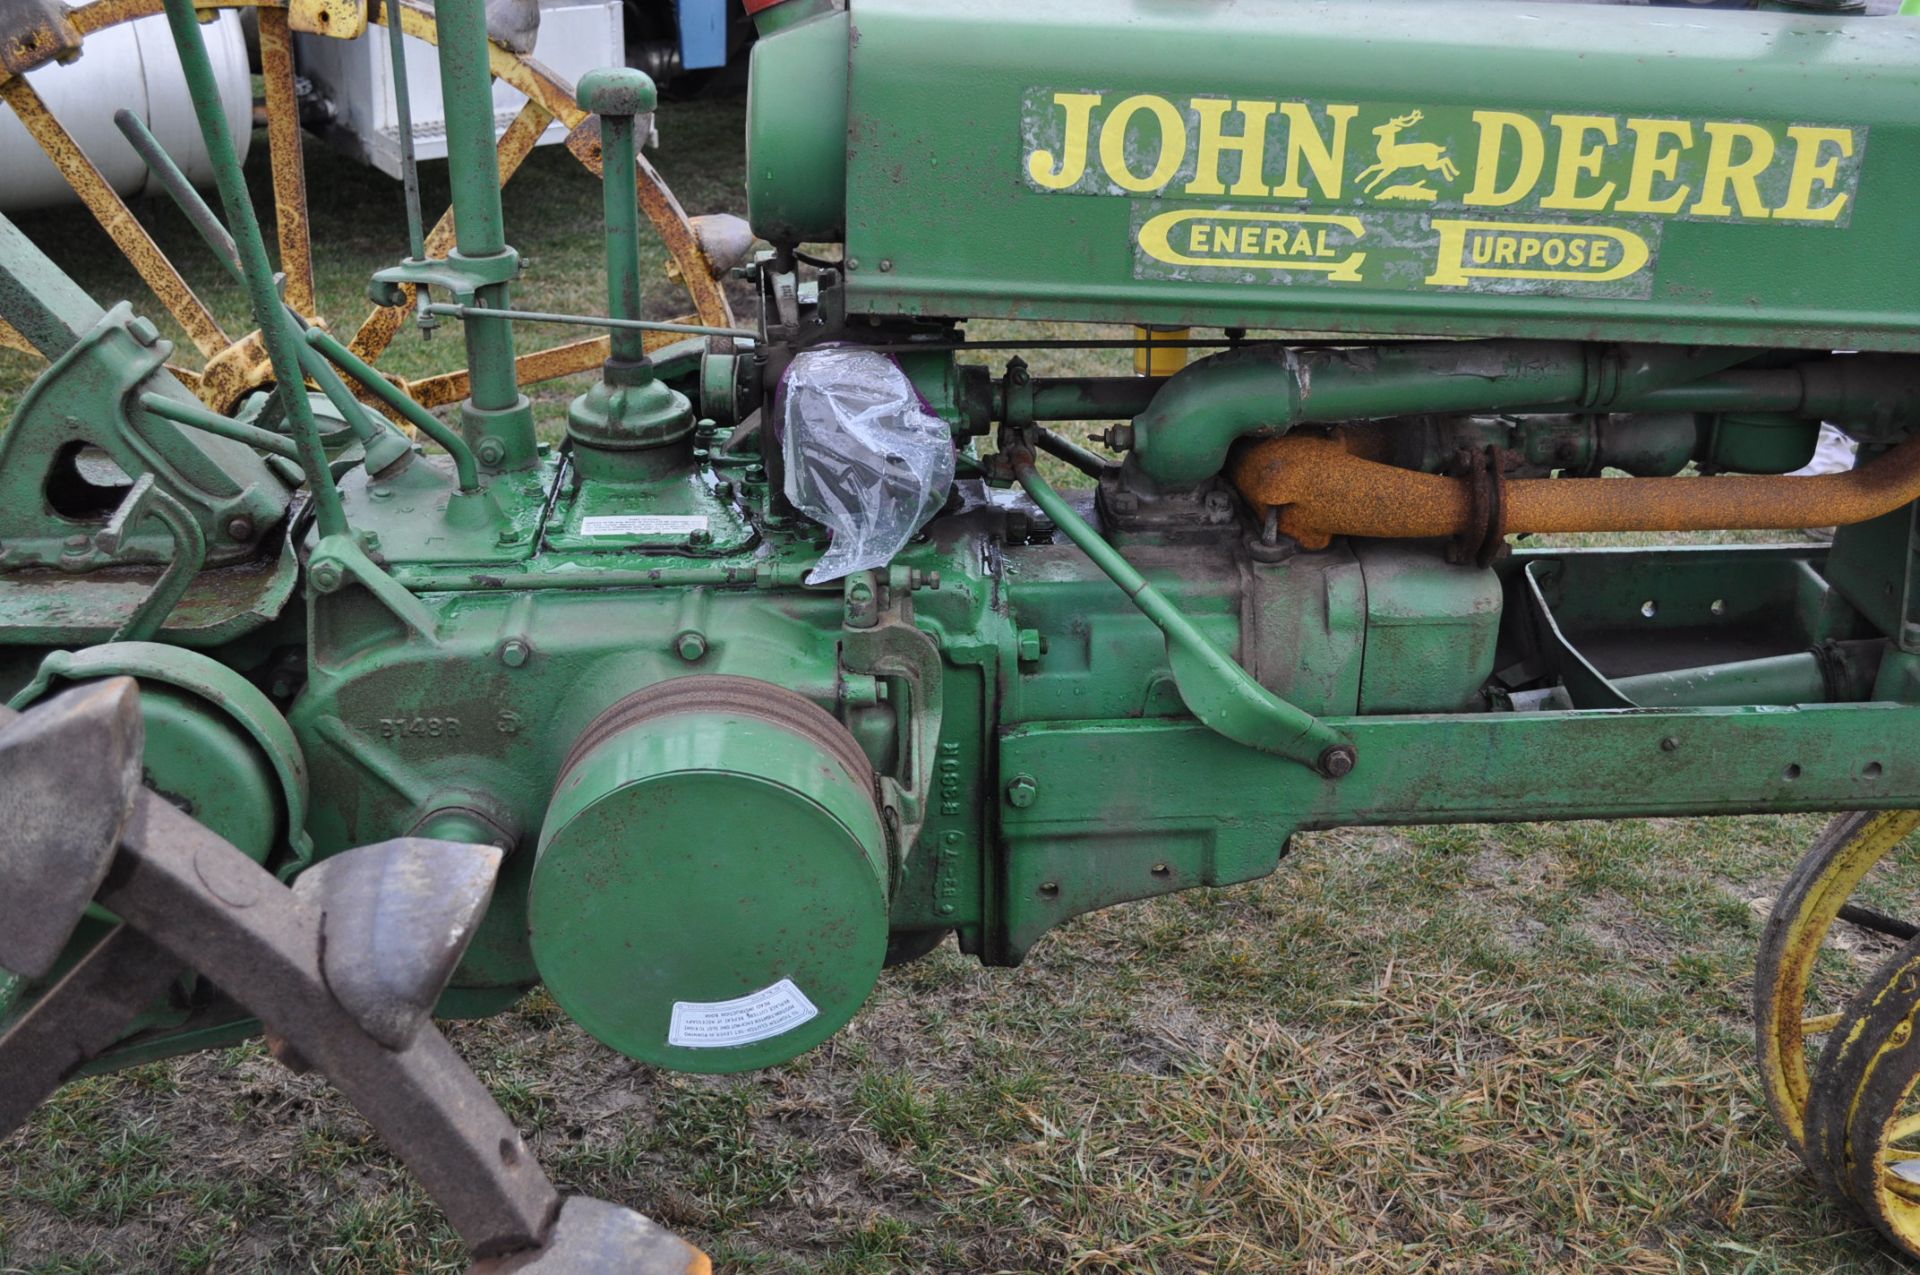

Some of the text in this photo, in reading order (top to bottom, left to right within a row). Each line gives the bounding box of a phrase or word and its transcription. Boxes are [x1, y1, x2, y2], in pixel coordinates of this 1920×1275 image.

[1028, 93, 1854, 221] JOHN DEERE
[1138, 209, 1649, 286] GENERAL PURPOSE
